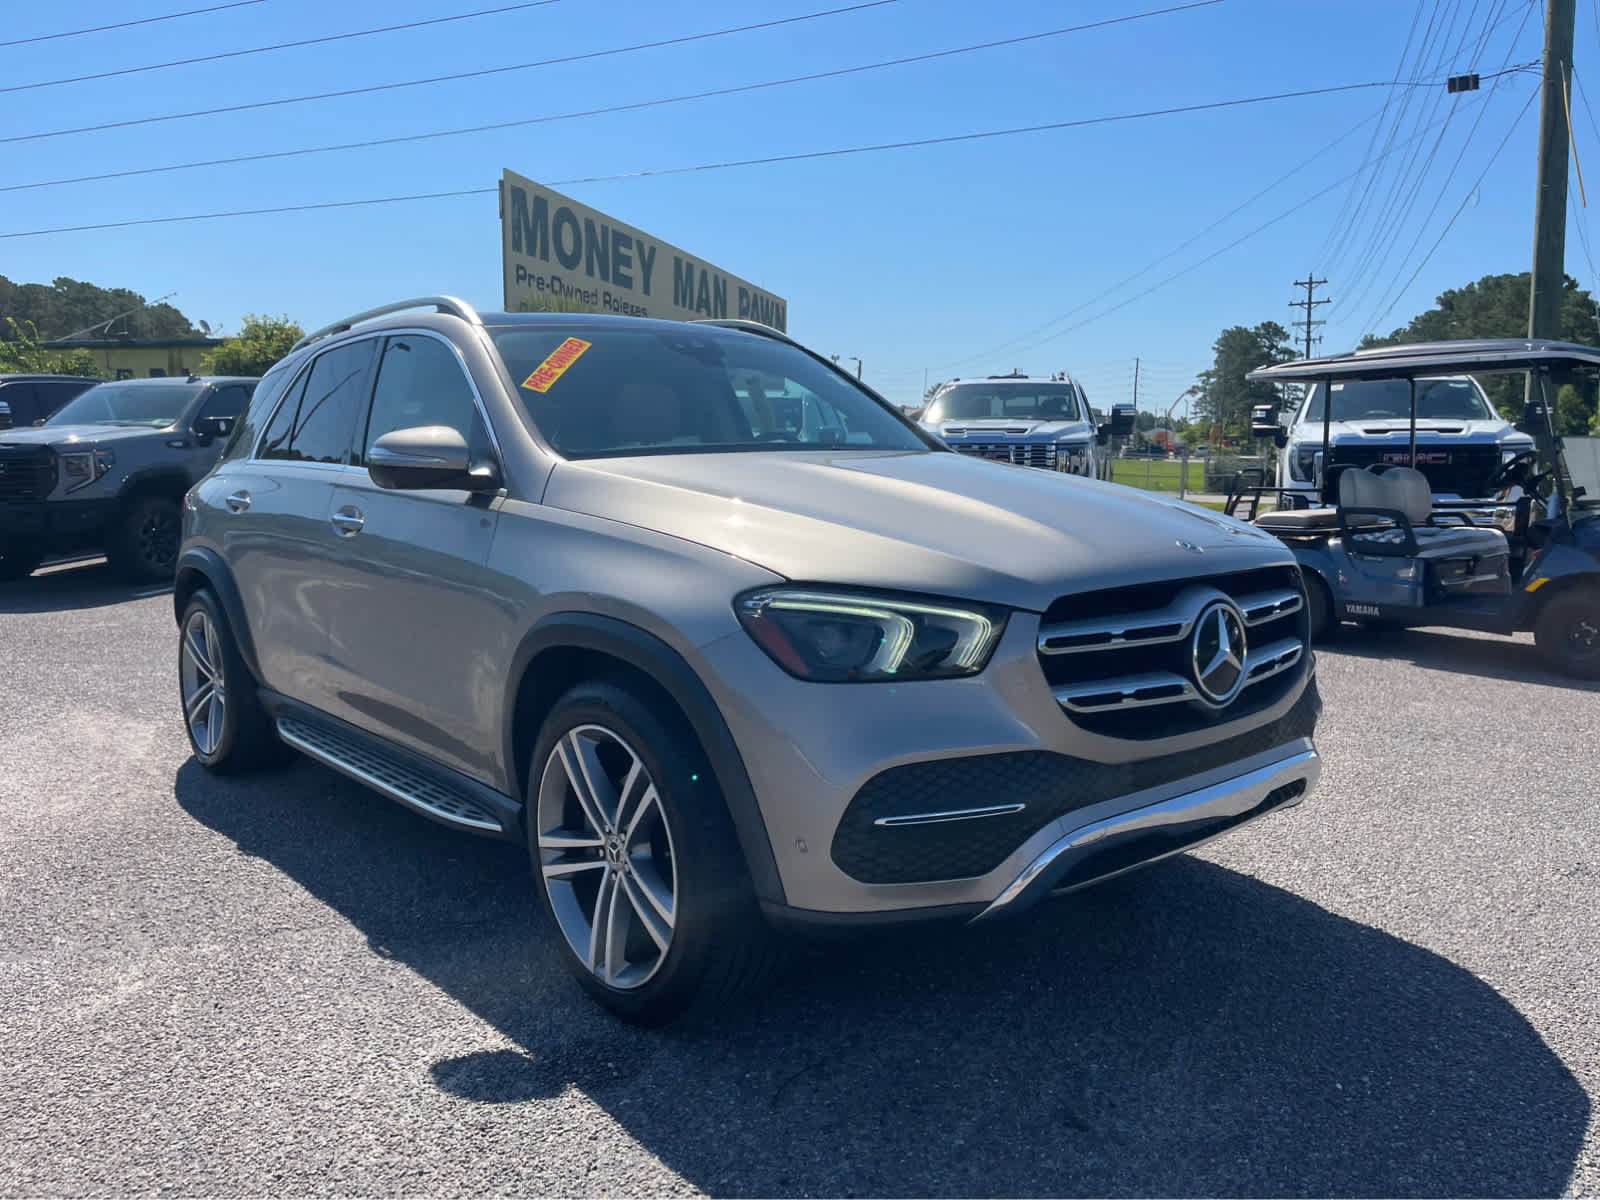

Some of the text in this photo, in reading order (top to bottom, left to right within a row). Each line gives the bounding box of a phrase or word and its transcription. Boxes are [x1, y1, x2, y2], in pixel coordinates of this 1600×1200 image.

[510, 184, 657, 297] MONEY
[673, 255, 728, 319] MAN
[515, 263, 599, 306] Pre-Owned
[526, 339, 586, 391] PRE-OWNED
[1345, 603, 1380, 617] YAMAHA
